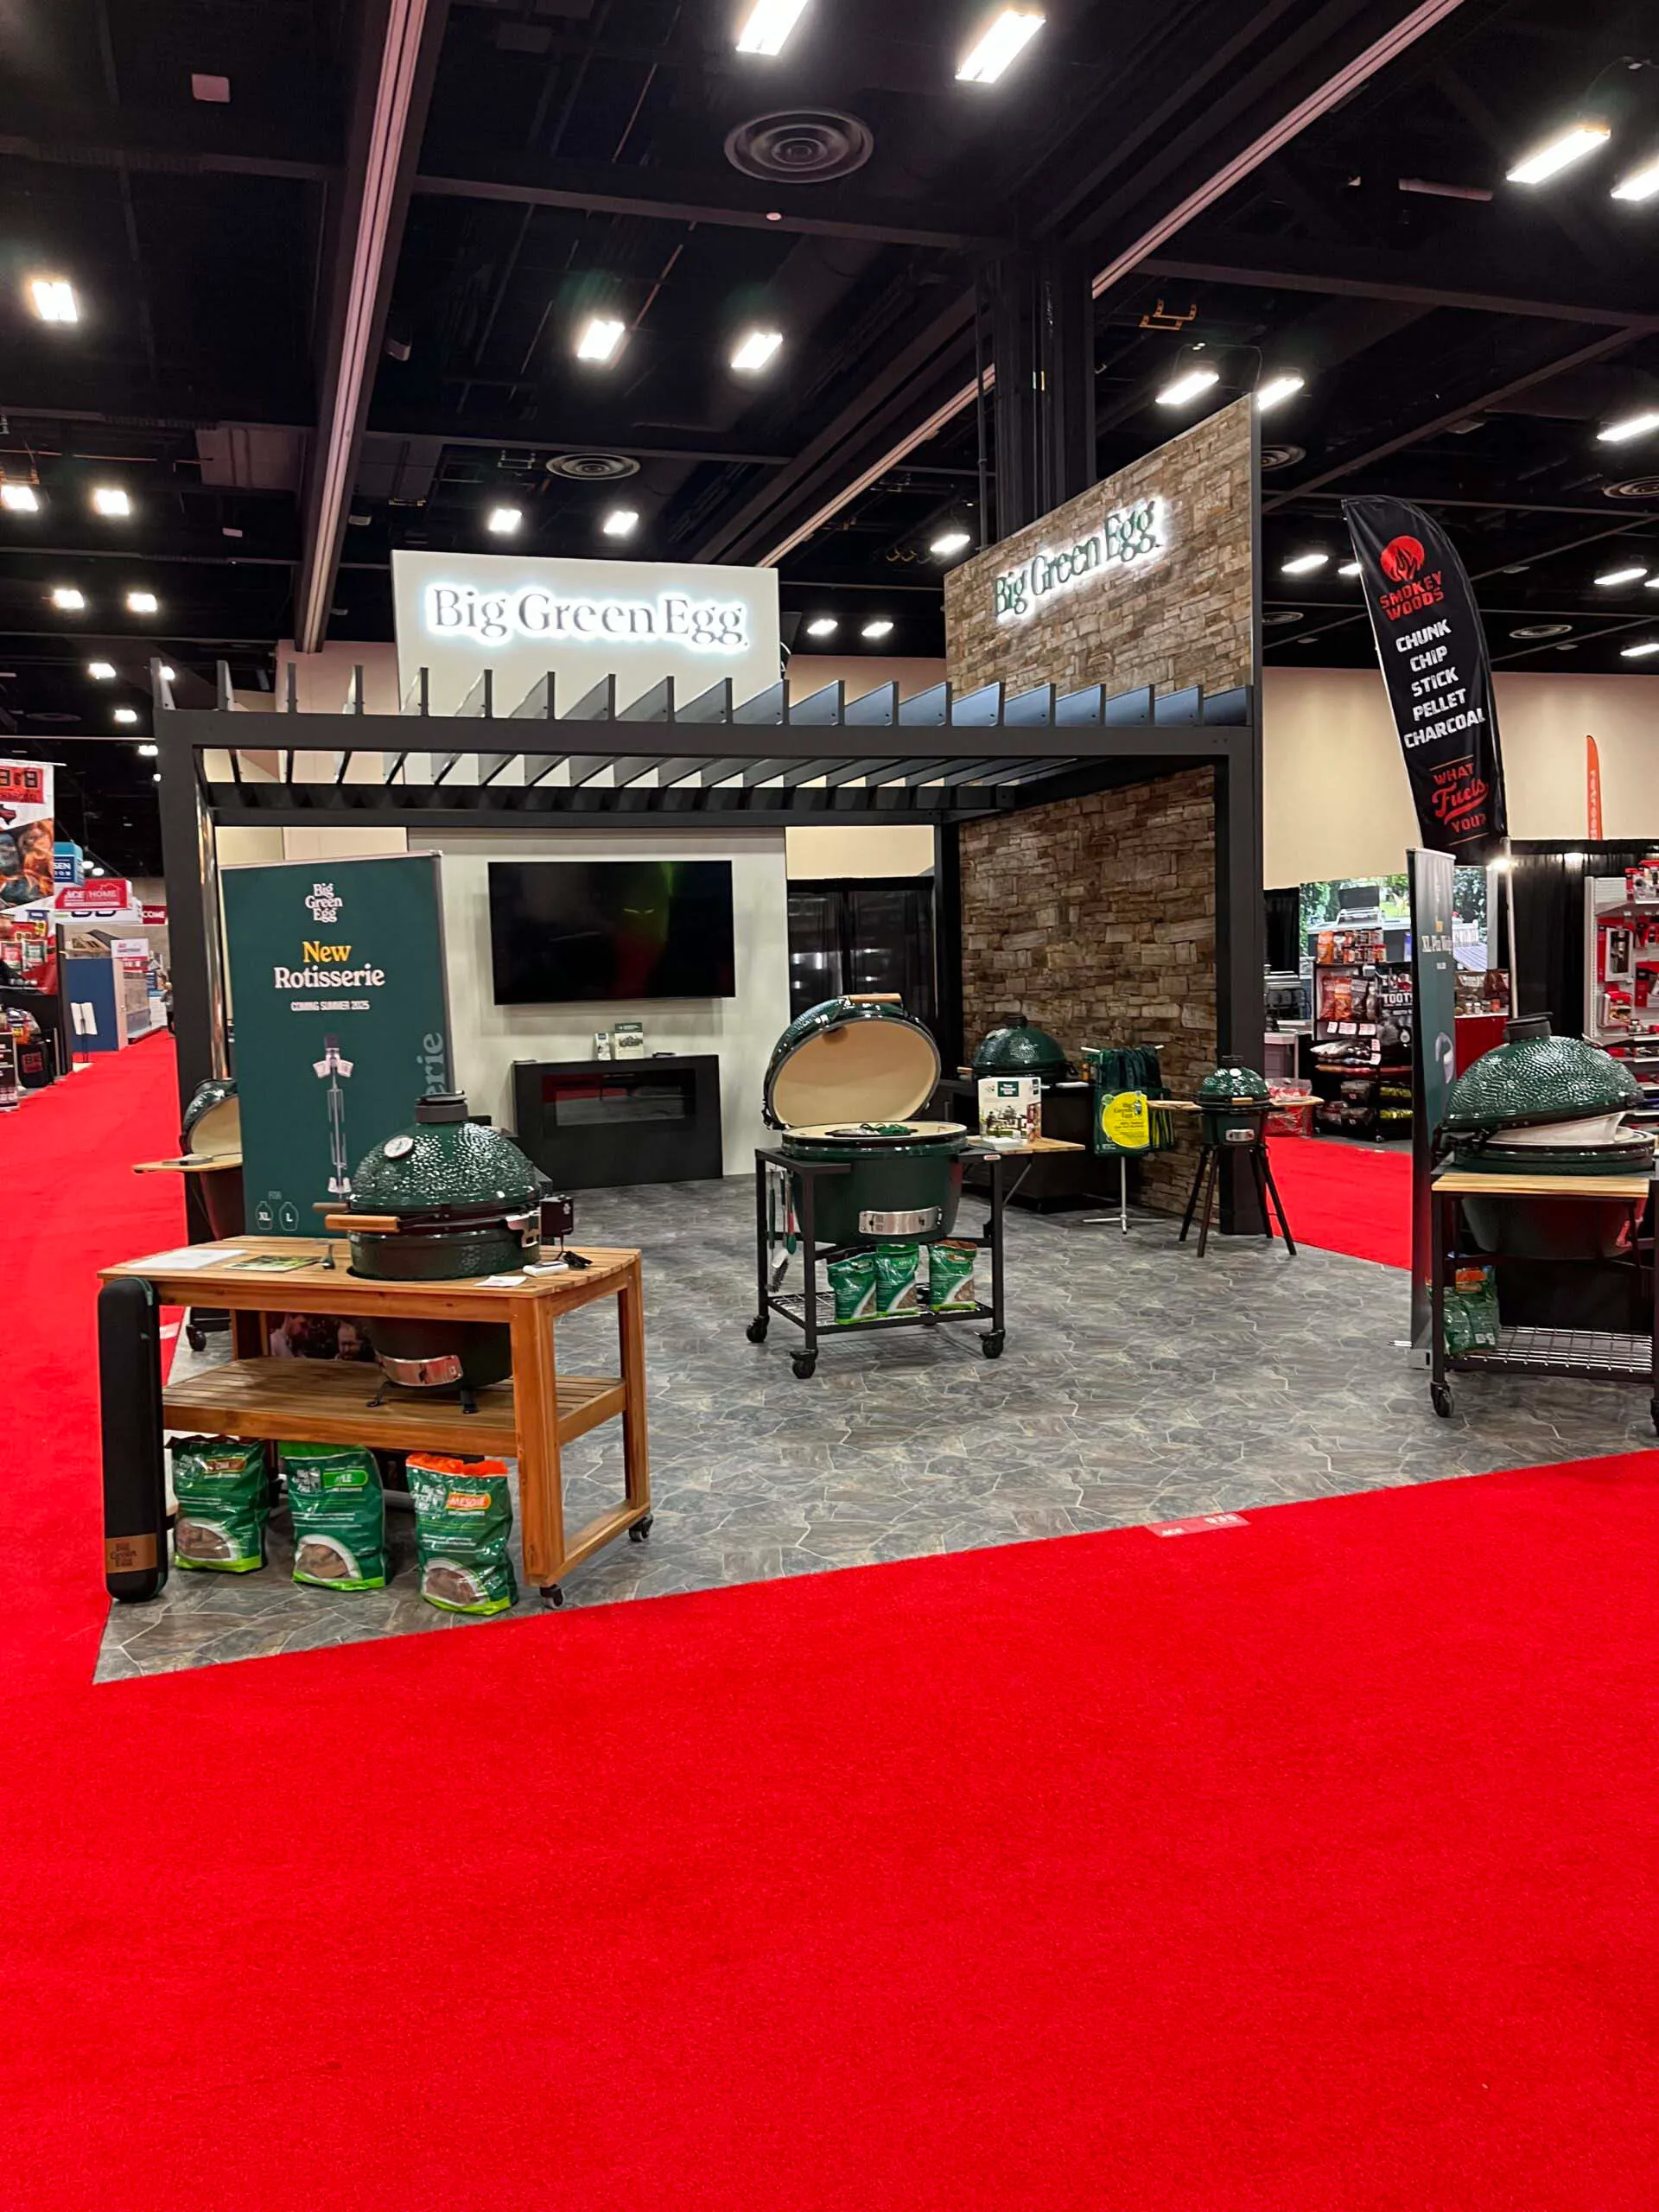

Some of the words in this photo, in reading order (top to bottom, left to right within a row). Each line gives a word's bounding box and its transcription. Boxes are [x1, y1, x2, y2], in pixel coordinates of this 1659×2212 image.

[995, 570, 1028, 615] Big
[1031, 537, 1102, 596] Green
[1105, 500, 1155, 563] Egg
[1380, 570, 1442, 609] SMOKEY
[1386, 587, 1445, 620] WOODS
[433, 588, 508, 638] Big
[518, 593, 656, 632] Green
[664, 598, 744, 646] Egg
[1395, 619, 1452, 652] CHUNK
[1410, 645, 1448, 672] CHIP
[1411, 667, 1459, 697] STICK
[1413, 689, 1466, 721] PELLET
[1403, 708, 1485, 749] CHARCOAL
[1433, 763, 1474, 785] WHAT
[1431, 779, 1488, 817] Fuels
[305, 895, 343, 909] Green
[313, 882, 335, 899] Big
[313, 907, 338, 923] Egg
[302, 941, 352, 963] New
[274, 963, 385, 988] Rotisserie
